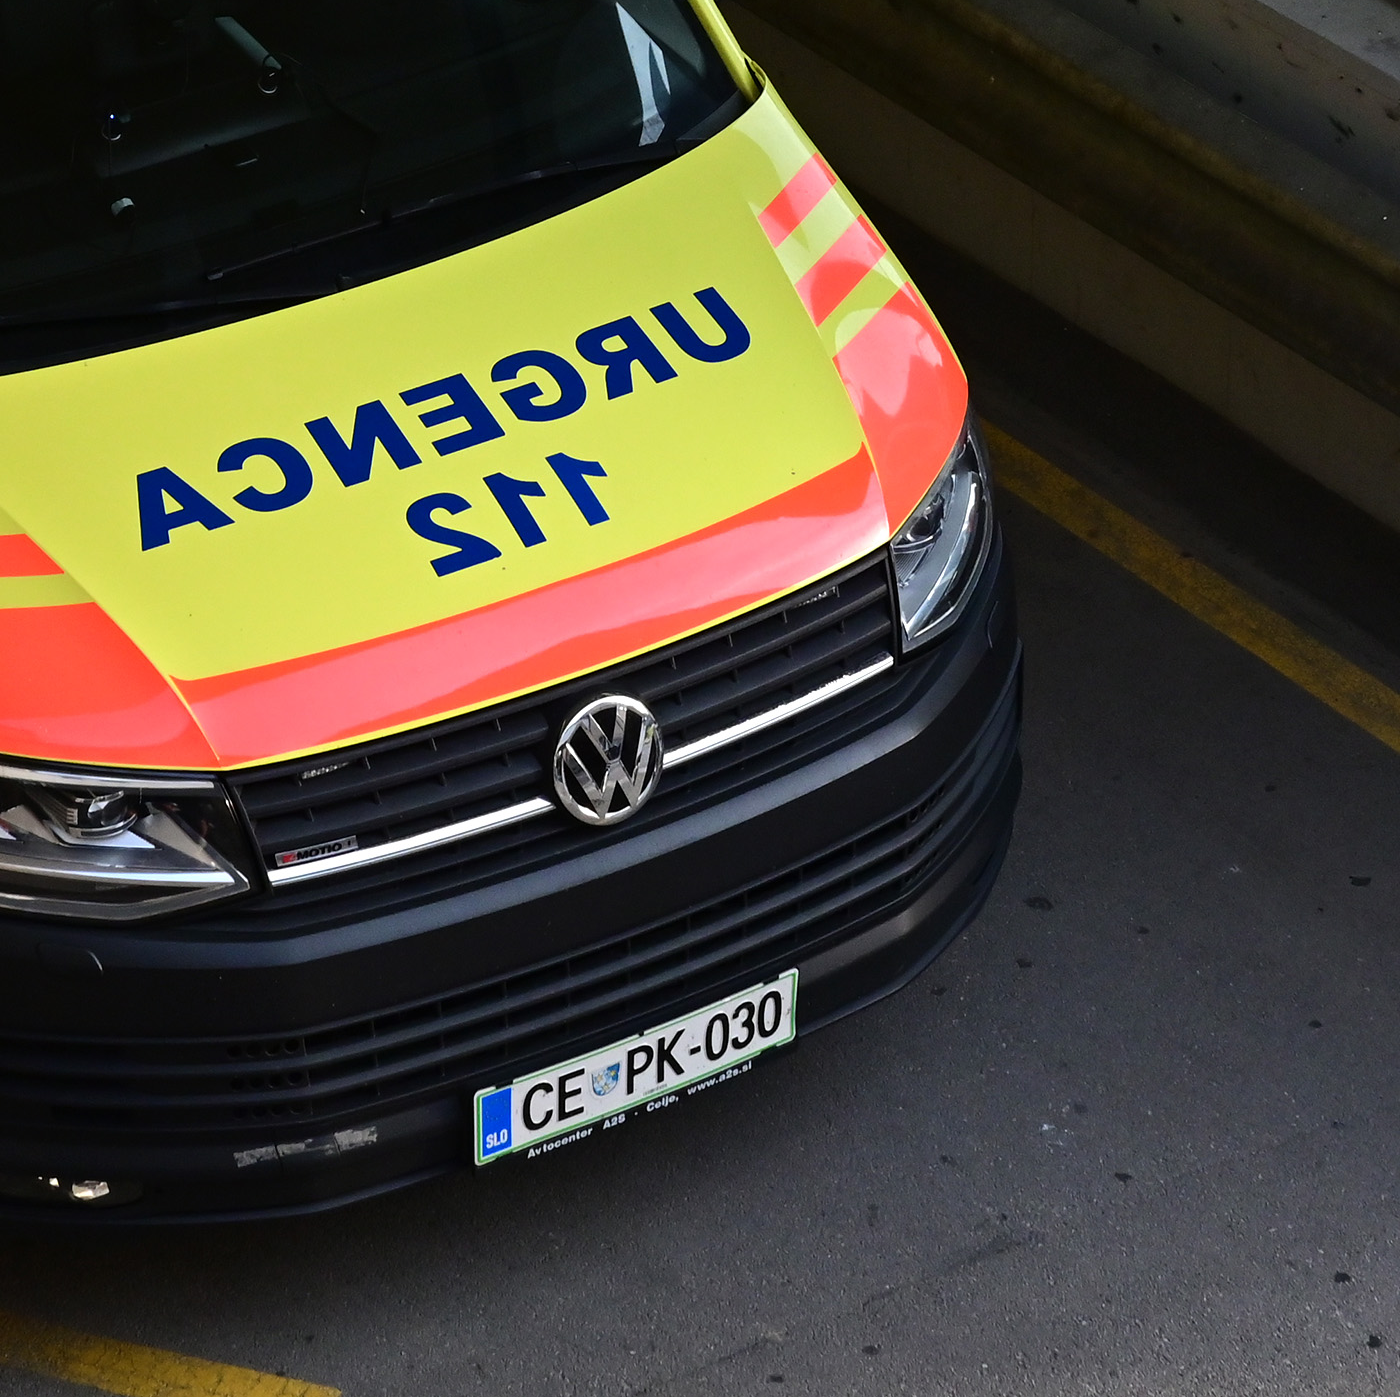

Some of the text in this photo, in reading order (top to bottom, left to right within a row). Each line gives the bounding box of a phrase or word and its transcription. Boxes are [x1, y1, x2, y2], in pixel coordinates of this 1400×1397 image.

[485, 989, 783, 1149] SLO CE PK-030
[527, 1126, 594, 1160] Avtocenter
[602, 1113, 626, 1130] A2S
[646, 1094, 680, 1113] Celje,
[686, 1060, 753, 1096] www.a2s.si
